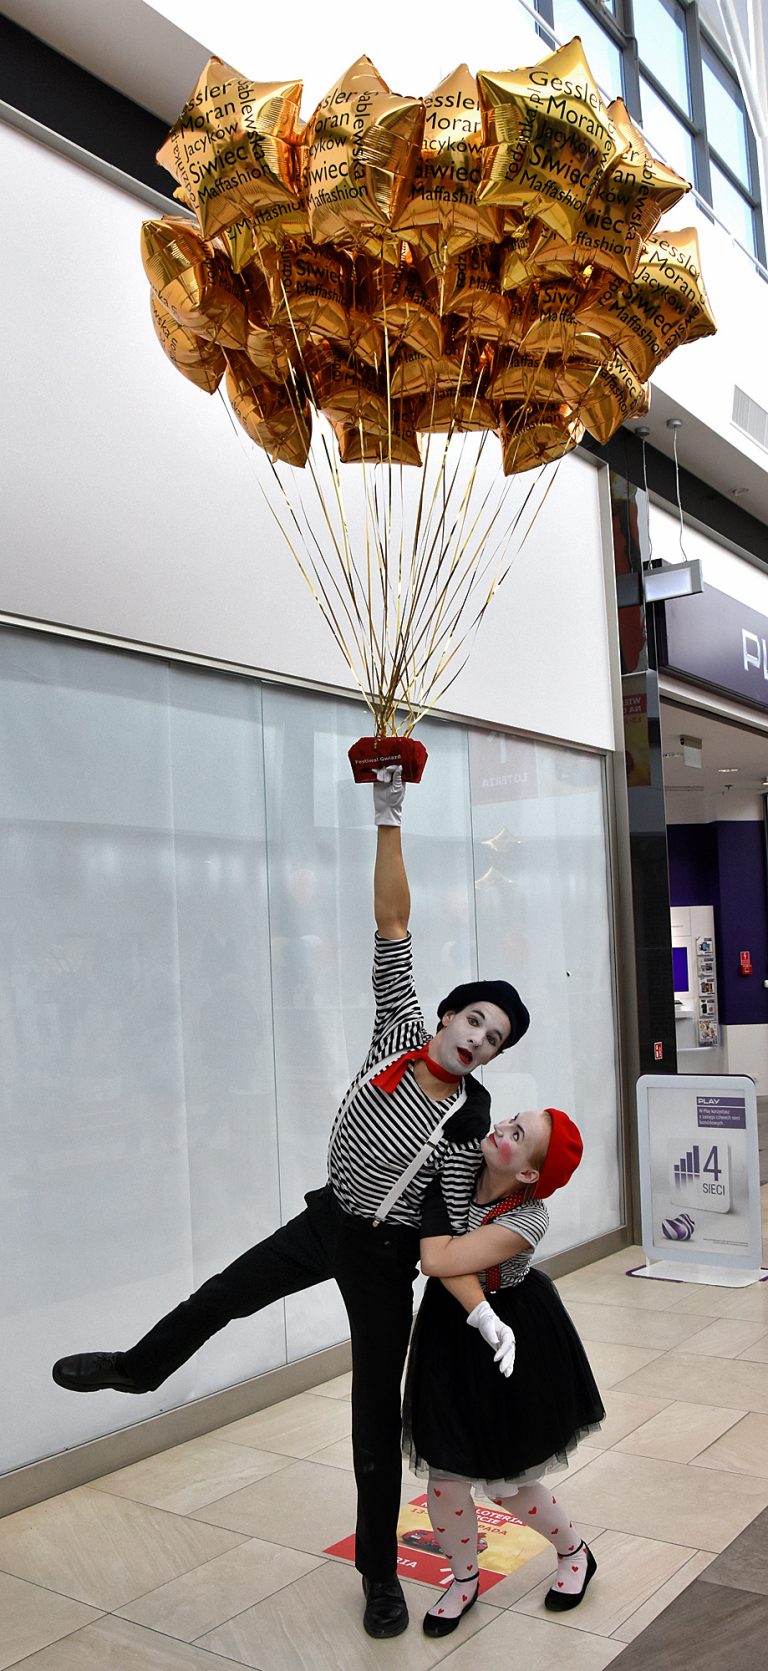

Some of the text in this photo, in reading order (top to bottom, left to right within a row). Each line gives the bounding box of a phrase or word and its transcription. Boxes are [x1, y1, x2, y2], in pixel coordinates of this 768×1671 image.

[184, 82, 232, 112] ssler
[424, 91, 480, 111] essler
[529, 71, 602, 112] Gessler
[181, 102, 236, 139] Moran
[313, 112, 350, 133] oran
[505, 87, 544, 182] rodzinka.pl
[547, 95, 604, 140] Moran
[184, 122, 239, 163] Jacyków
[422, 136, 482, 155] acyków
[538, 123, 599, 159] Jacyków
[189, 146, 248, 184] Siwiec
[303, 161, 349, 189] Siwiec
[529, 144, 589, 189] Siwiec
[198, 164, 274, 204] Maffashion
[307, 185, 369, 211] Maffashion
[583, 210, 625, 233] wiec
[576, 230, 632, 256] ffashion
[634, 266, 685, 314] Jacyków
[649, 251, 696, 302] Moran
[622, 282, 672, 335] Siwiec
[600, 368, 628, 416] affashion
[615, 358, 637, 398] wiec
[742, 628, 768, 681] PL
[355, 754, 402, 765] Festiwal Gwiazd
[703, 1145, 722, 1181] 4
[702, 1183, 726, 1196] SIECI
